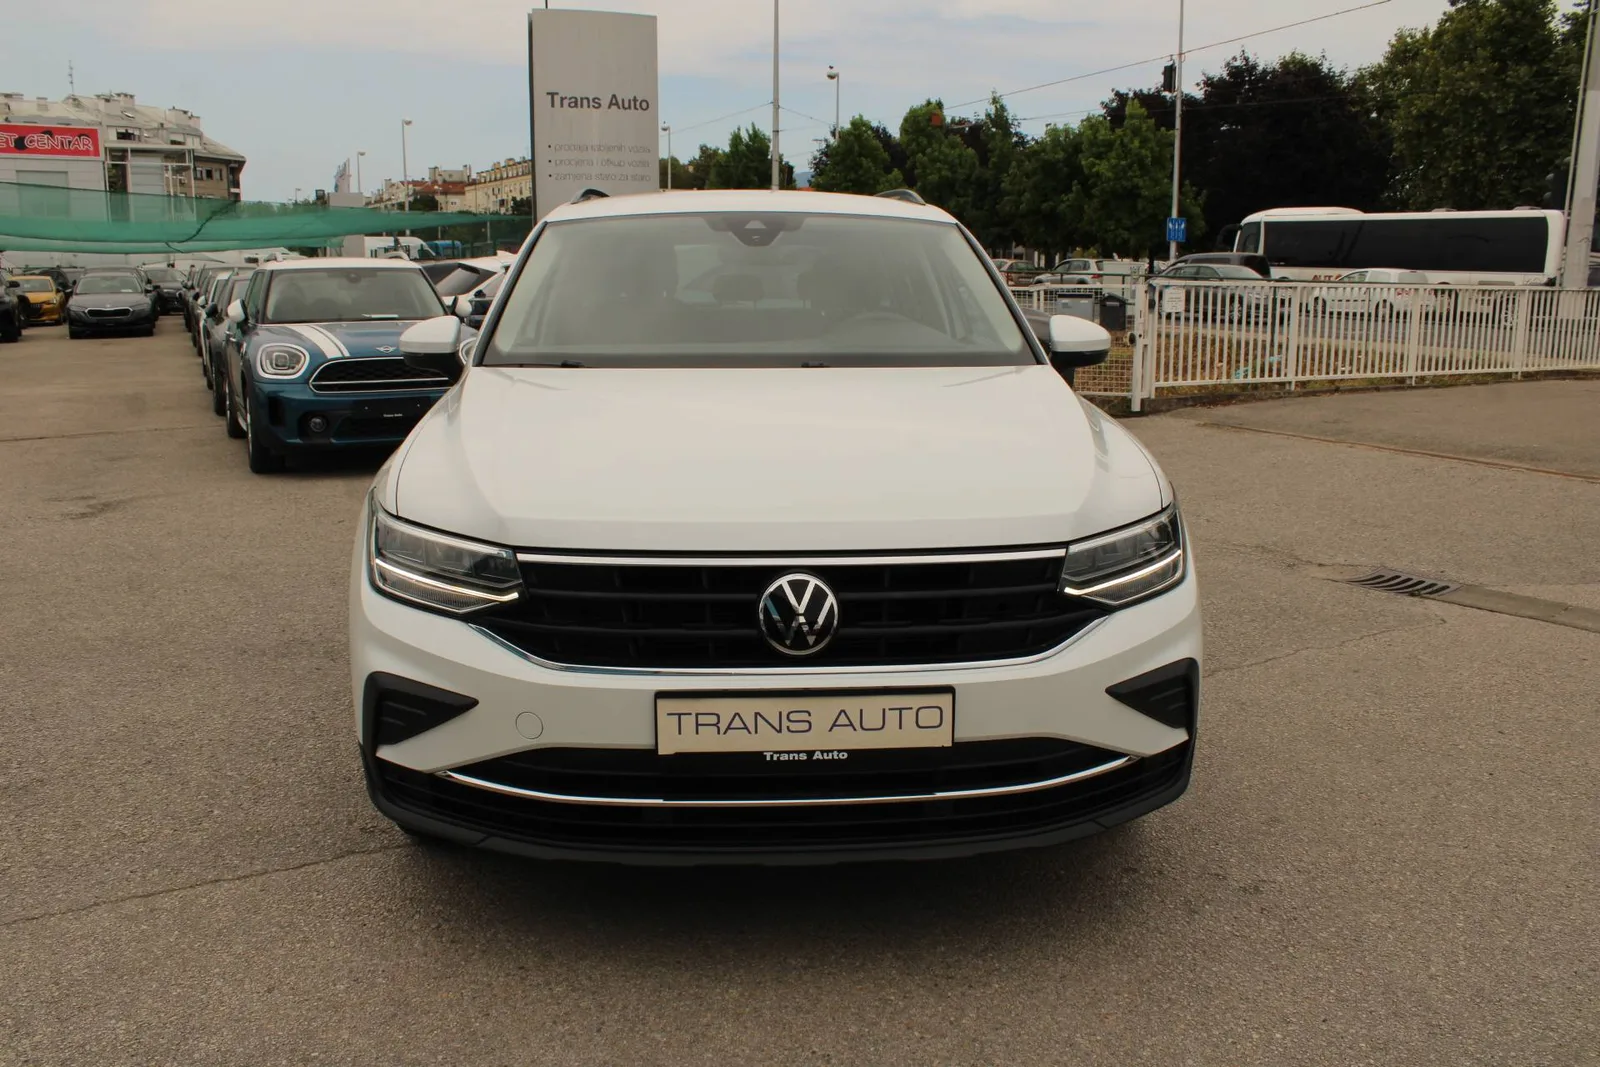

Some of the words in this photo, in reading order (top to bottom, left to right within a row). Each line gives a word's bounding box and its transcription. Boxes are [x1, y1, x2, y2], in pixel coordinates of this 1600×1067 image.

[546, 92, 602, 109] Trans
[607, 93, 650, 111] Auto
[24, 134, 94, 151] CENTAR
[594, 173, 617, 181] staro
[667, 710, 812, 735] TRANS
[828, 705, 944, 733] AUTO
[763, 751, 808, 761] Trans
[812, 750, 848, 760] Auto
